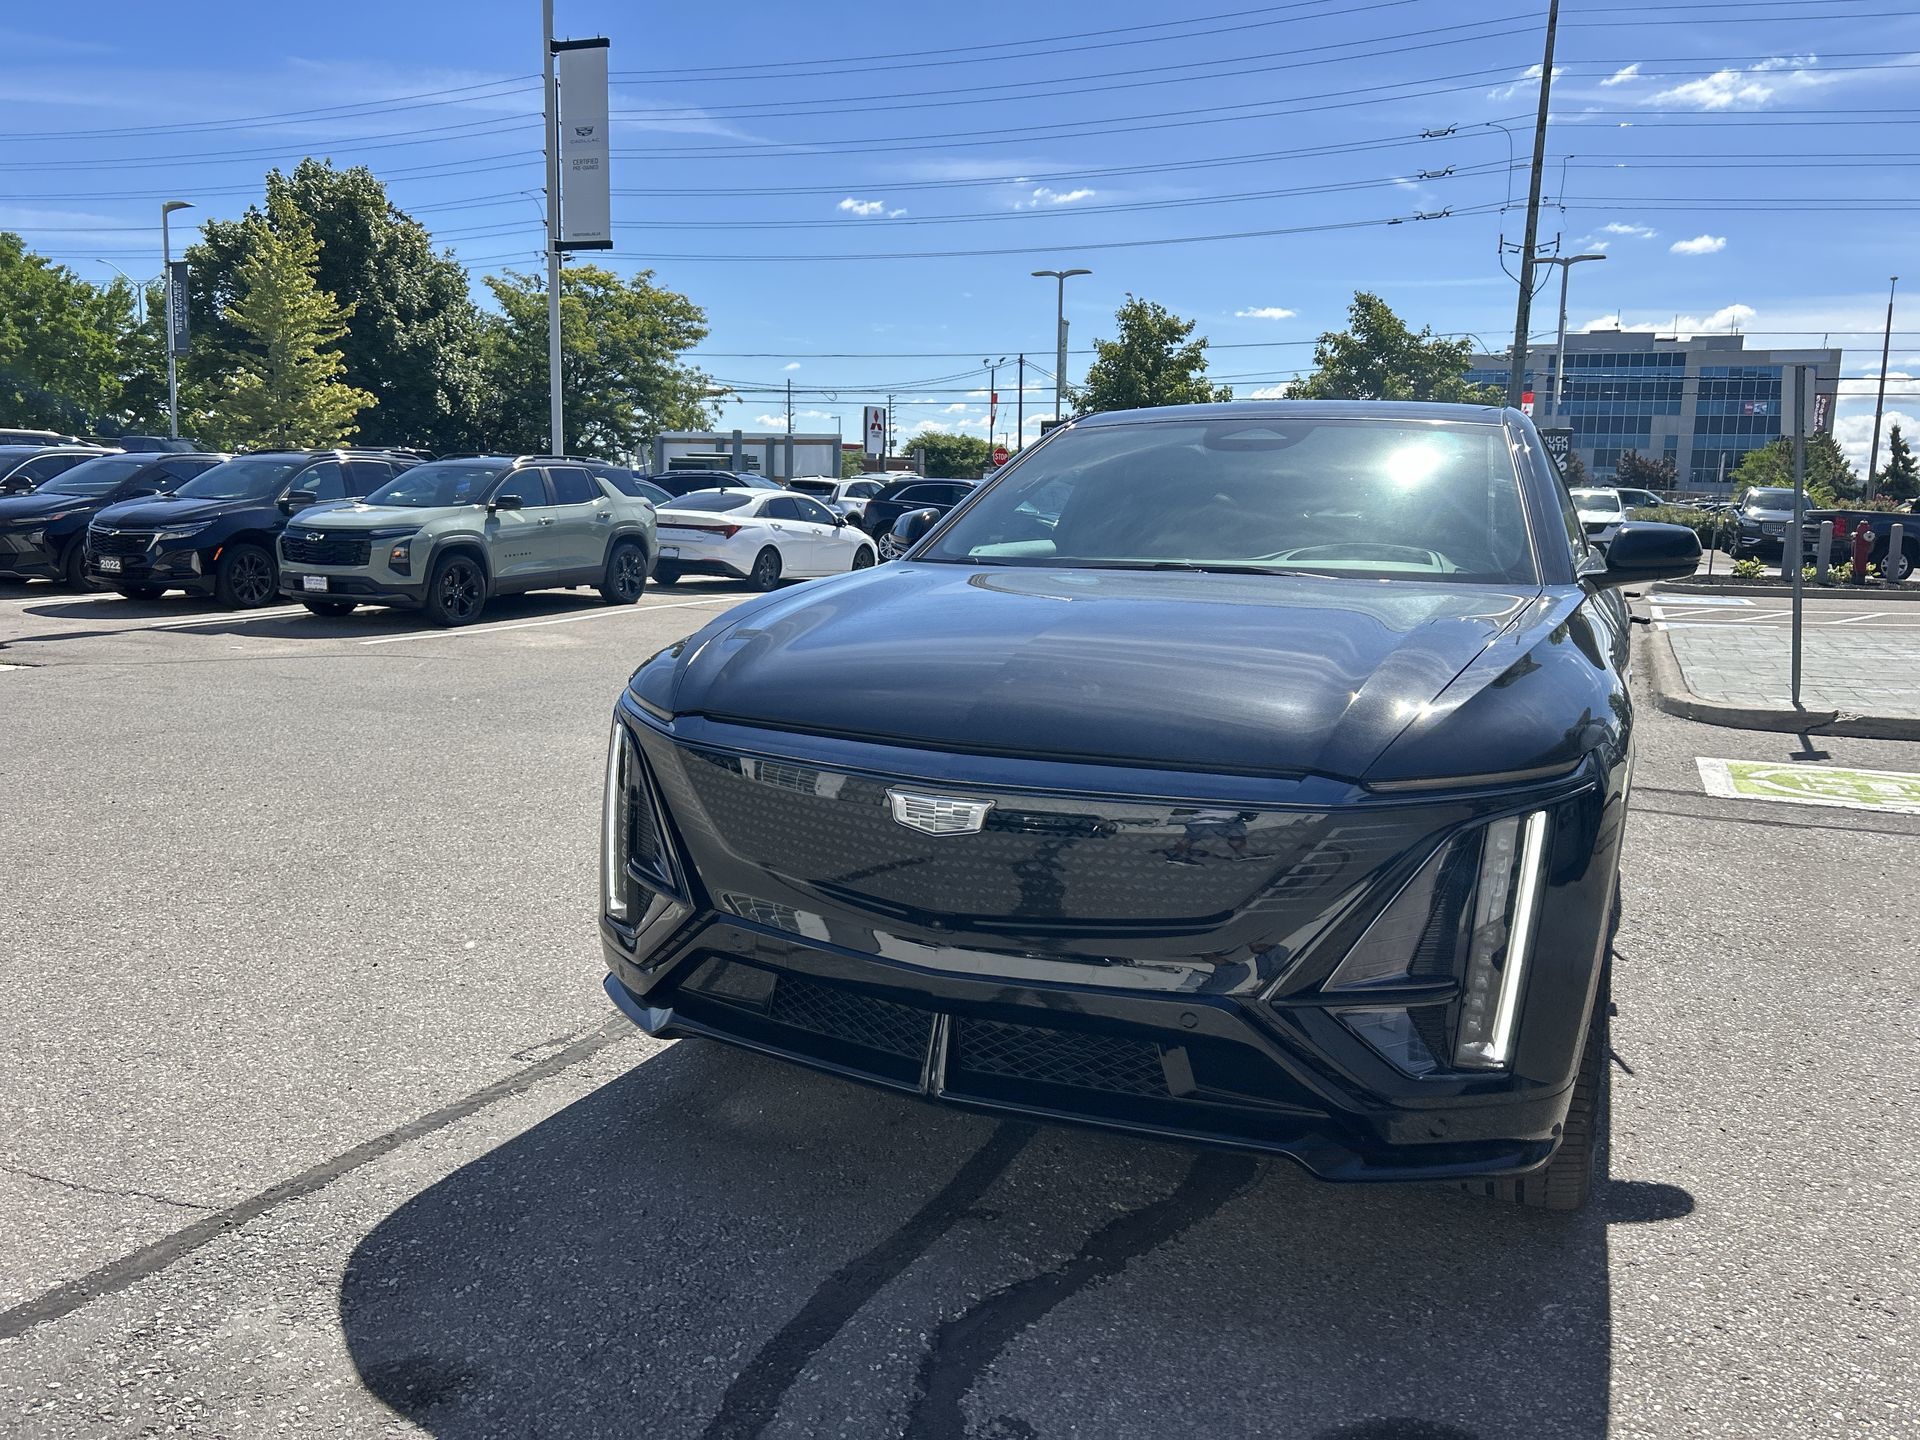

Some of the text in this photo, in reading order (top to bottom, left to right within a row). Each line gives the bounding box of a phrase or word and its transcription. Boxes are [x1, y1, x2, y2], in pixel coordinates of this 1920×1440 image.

[572, 157, 599, 166] CERTIFIED
[1818, 398, 1827, 414] Group
[994, 453, 1008, 461] STOP
[100, 559, 121, 570] 2022
